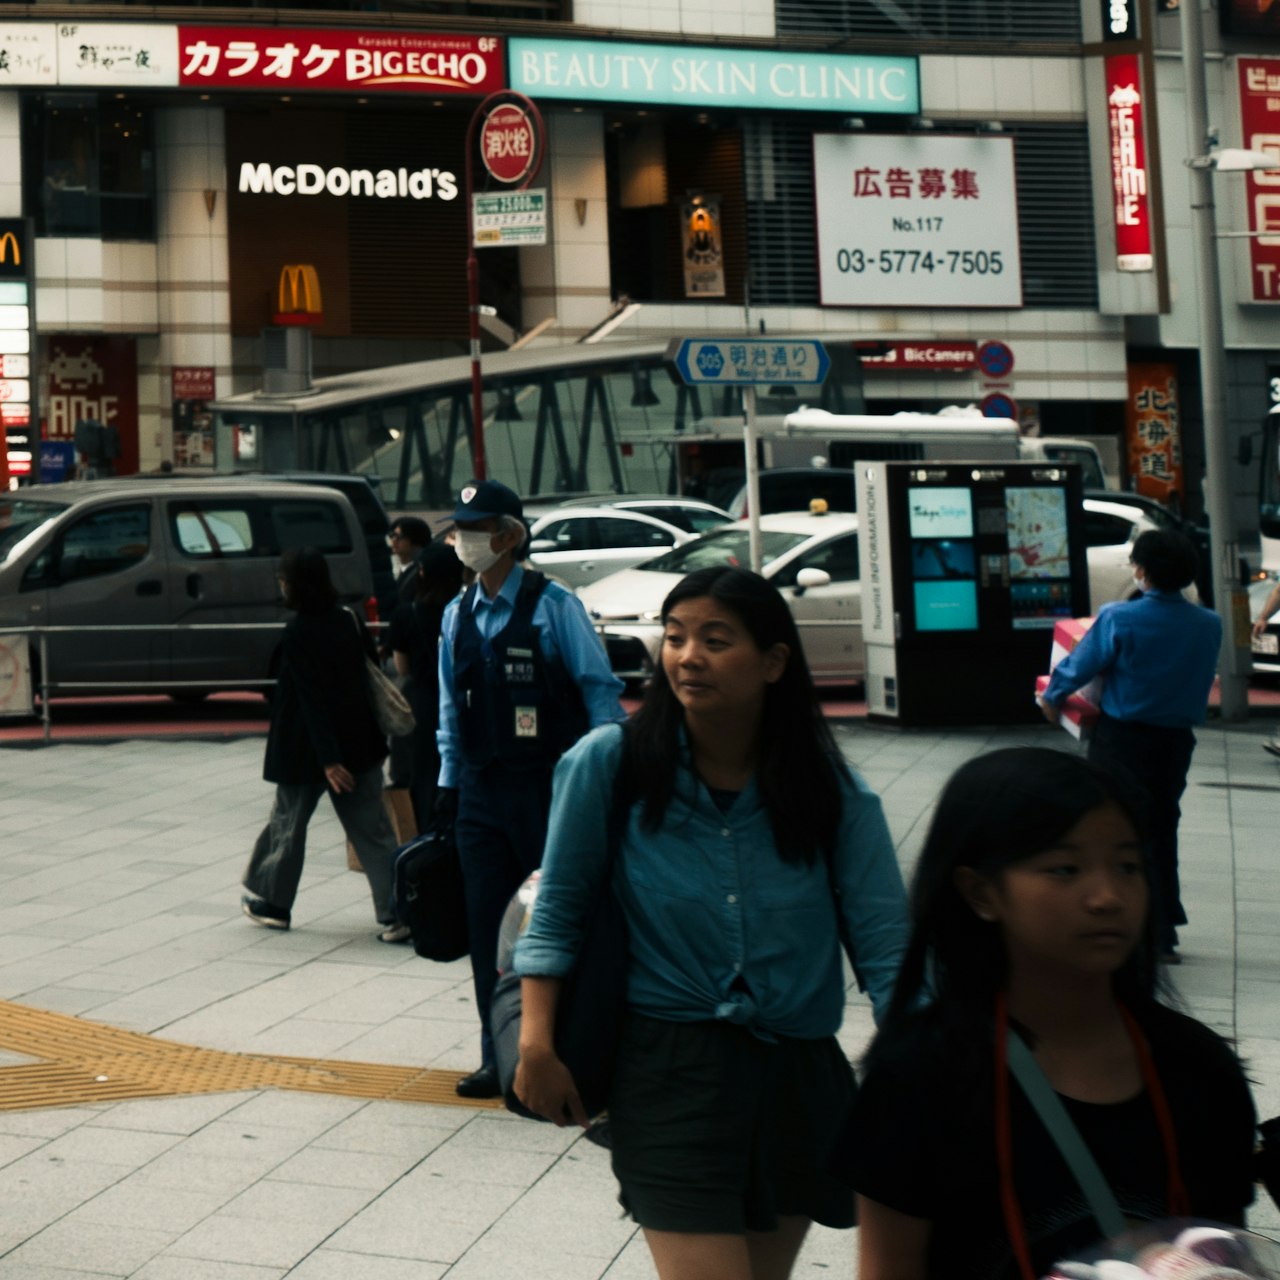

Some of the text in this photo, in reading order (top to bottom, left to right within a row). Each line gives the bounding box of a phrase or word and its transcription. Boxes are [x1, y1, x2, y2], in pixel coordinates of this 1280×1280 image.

[61, 25, 79, 38] 6F
[477, 36, 498, 53] 6F
[182, 40, 341, 80] カラオケ
[521, 50, 907, 103] BEAUTY SKIN CLINIC
[486, 128, 529, 159] 消火栓
[239, 162, 458, 201] McDonald's
[851, 166, 981, 201] 広告募集
[891, 215, 944, 234] No.117
[836, 248, 1004, 276] 03-5774-7505
[698, 346, 808, 370] 305 明治通り
[903, 348, 975, 363] BicCamera
[1136, 388, 1176, 481] 北海道
[865, 484, 882, 584] INFORMATION
